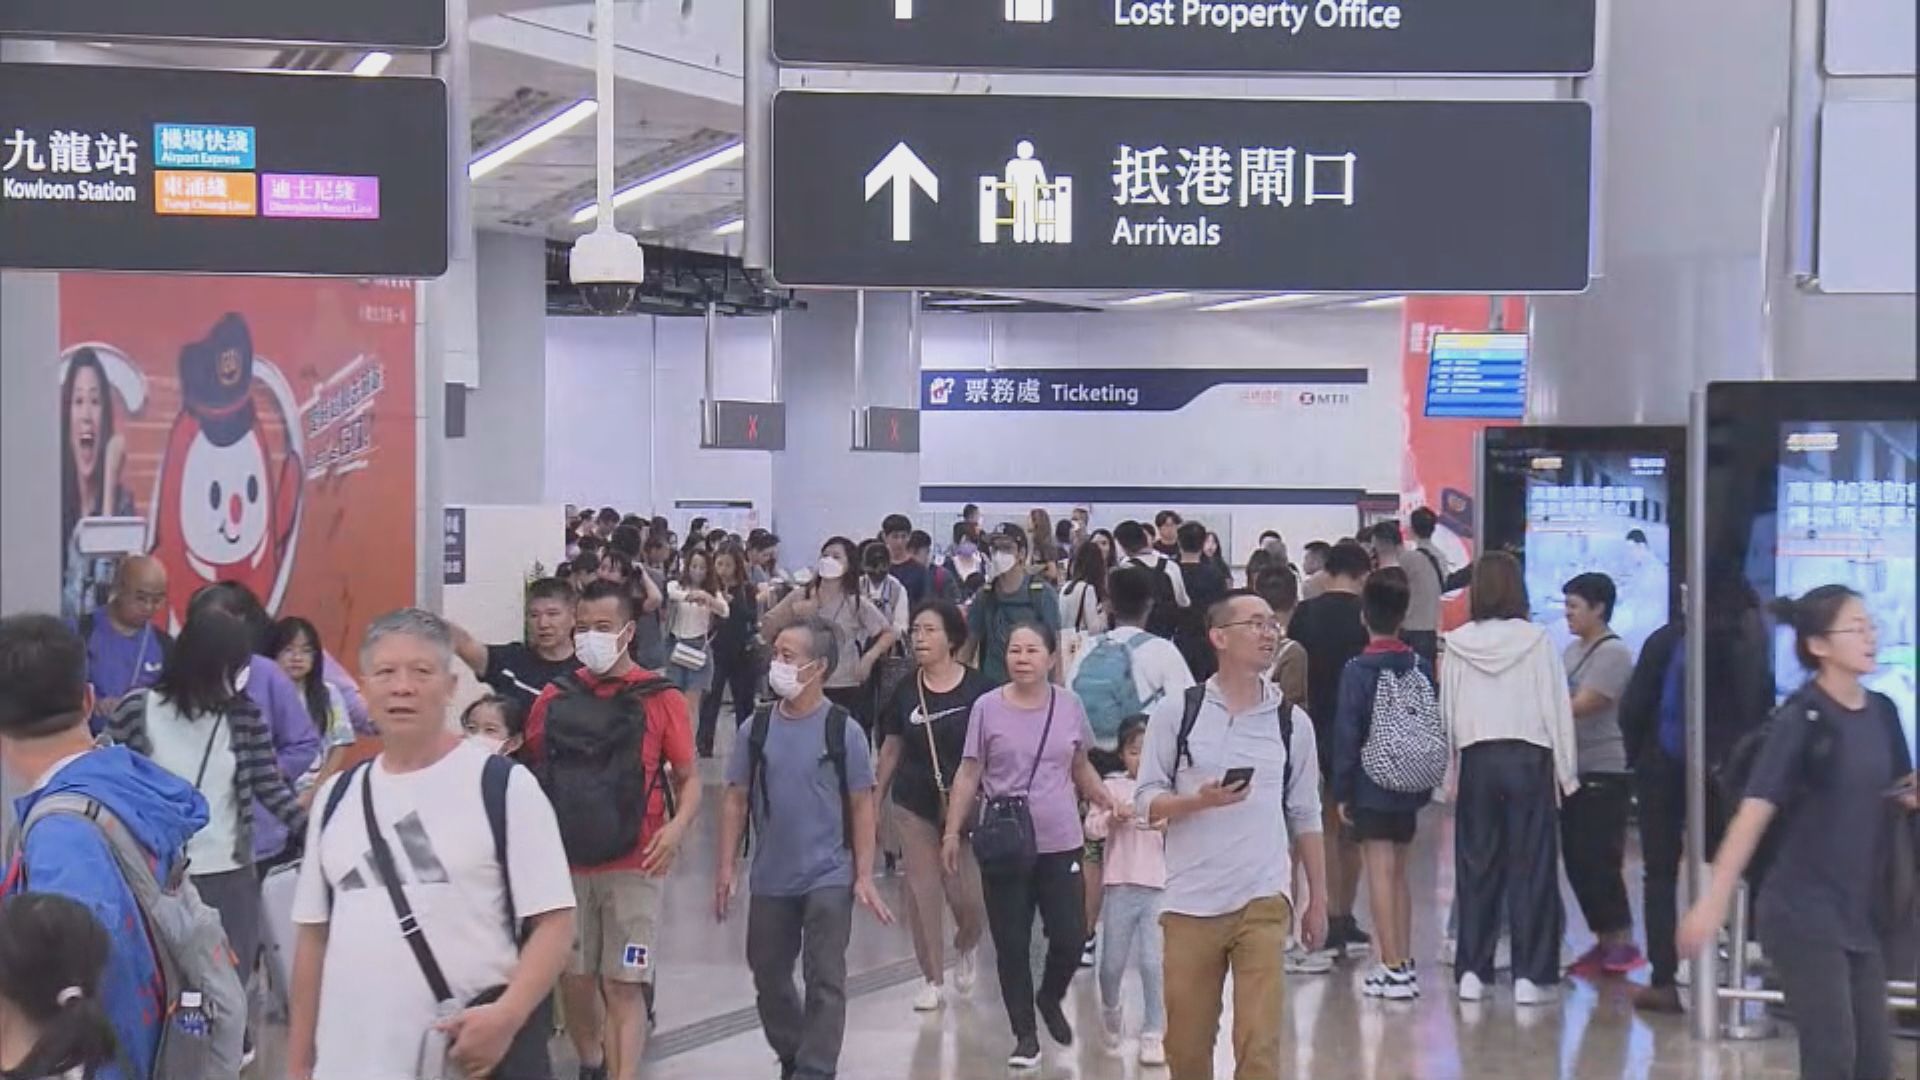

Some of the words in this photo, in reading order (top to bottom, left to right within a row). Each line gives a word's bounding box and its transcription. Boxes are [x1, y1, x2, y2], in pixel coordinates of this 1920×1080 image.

[1114, 0, 1175, 26] Lost
[1182, 0, 1309, 33] Property
[1314, 0, 1401, 29] Office
[2, 129, 138, 175] 九龍站
[161, 151, 199, 165] Airport
[3, 177, 74, 201] Kowloon
[78, 180, 136, 202] Station
[1112, 144, 1358, 208] 抵港閘口
[1111, 216, 1221, 246] Arrivals
[965, 378, 1040, 404] 票務處
[1051, 383, 1139, 406] Ticketing
